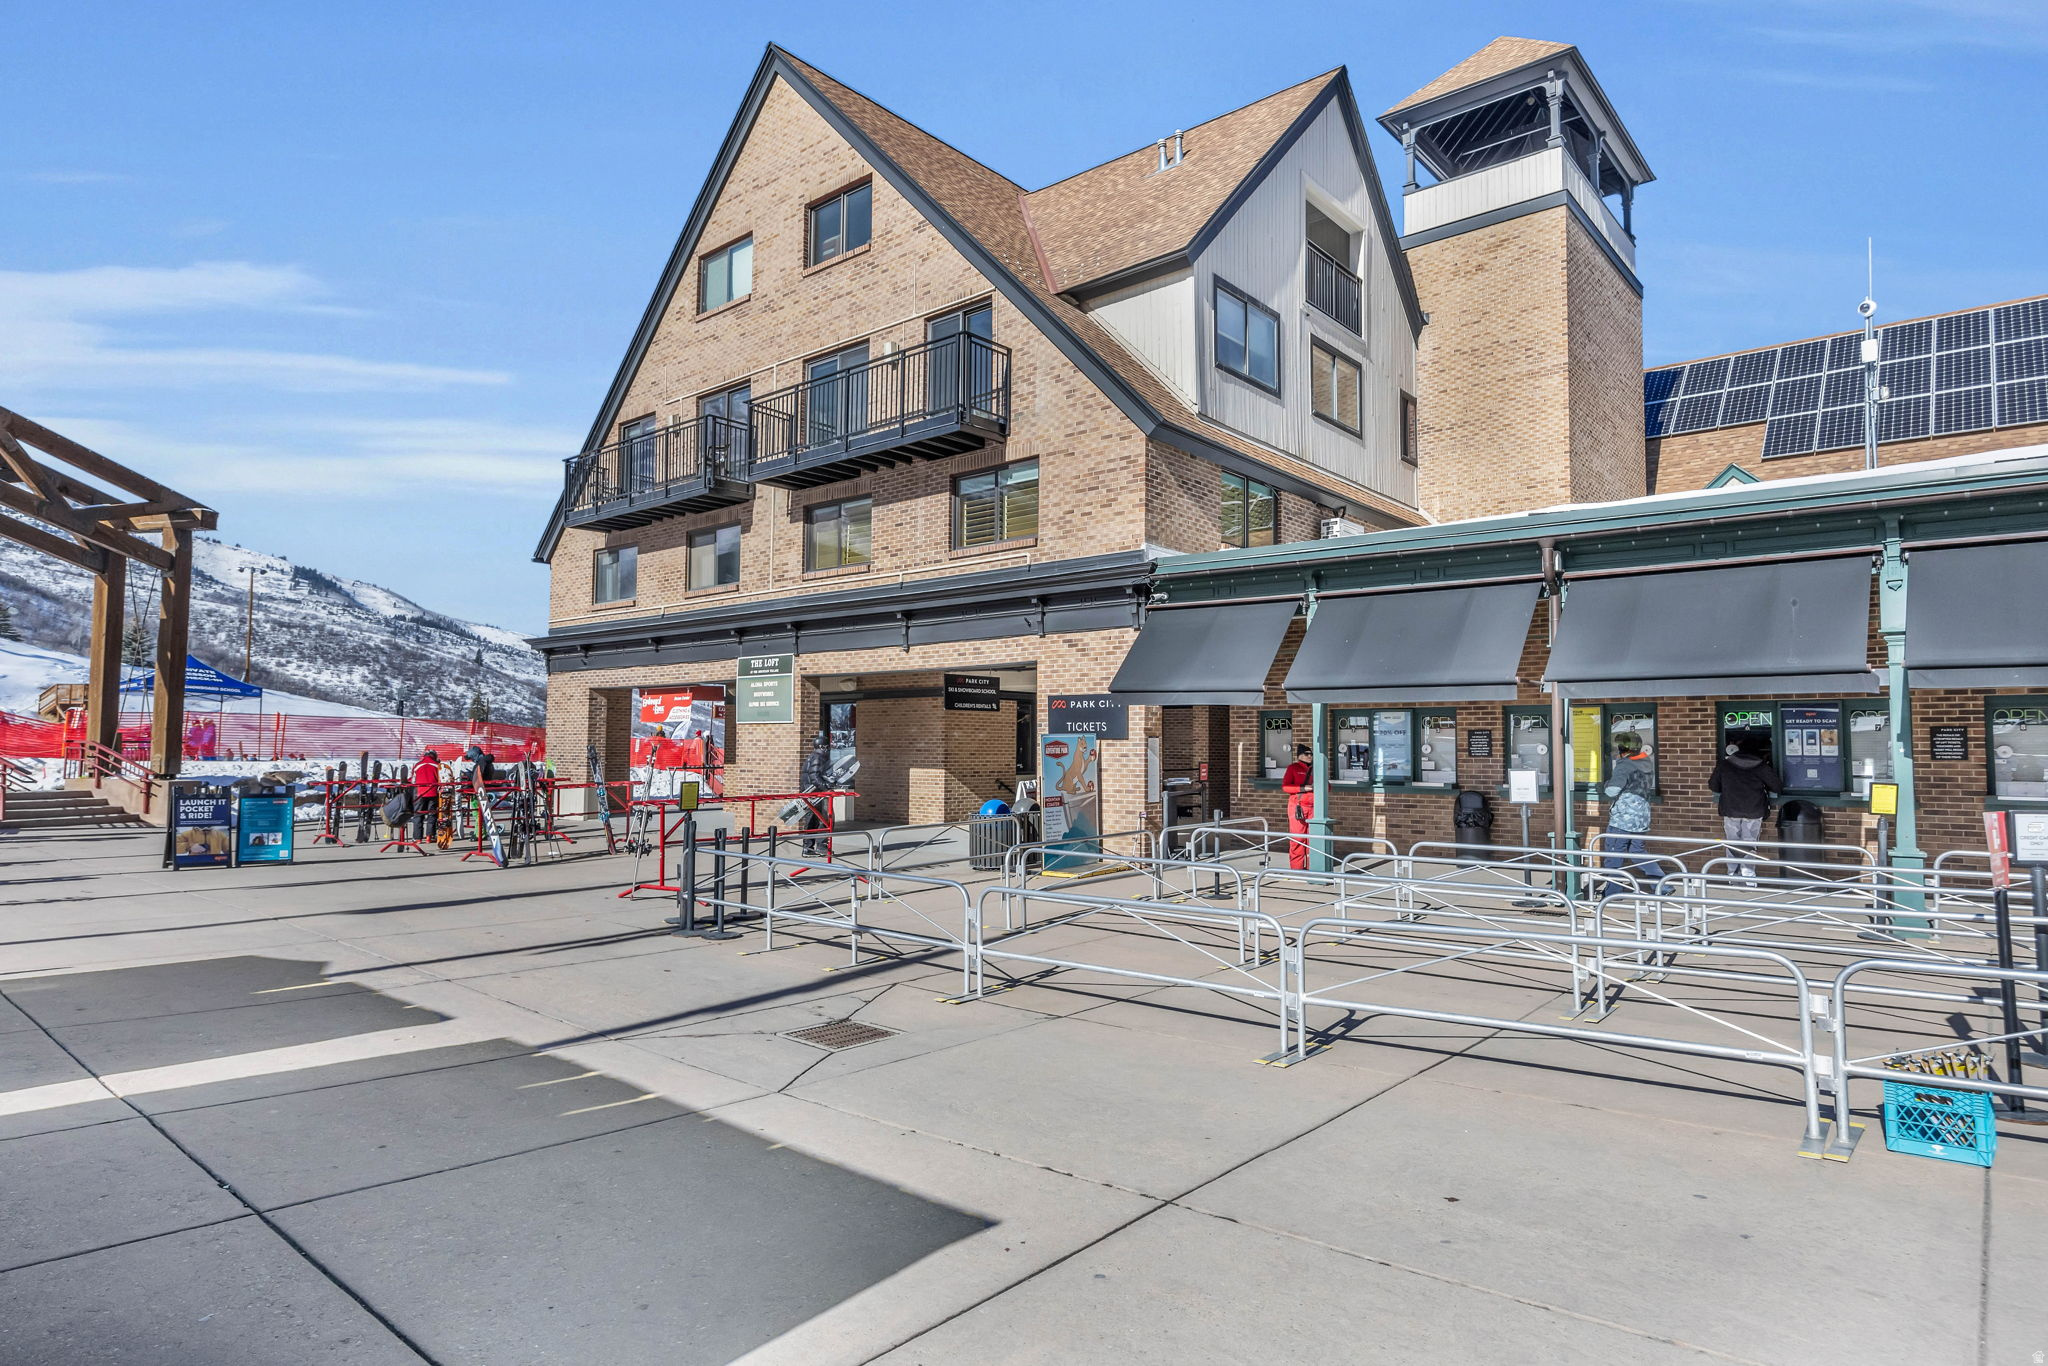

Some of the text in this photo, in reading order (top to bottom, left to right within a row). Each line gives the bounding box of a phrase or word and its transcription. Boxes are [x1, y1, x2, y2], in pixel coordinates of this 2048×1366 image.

[750, 658, 779, 668] THE LOFT
[1071, 700, 1095, 708] PARK
[1725, 712, 1772, 726] OPEN
[1067, 722, 1107, 732] TICKETS
